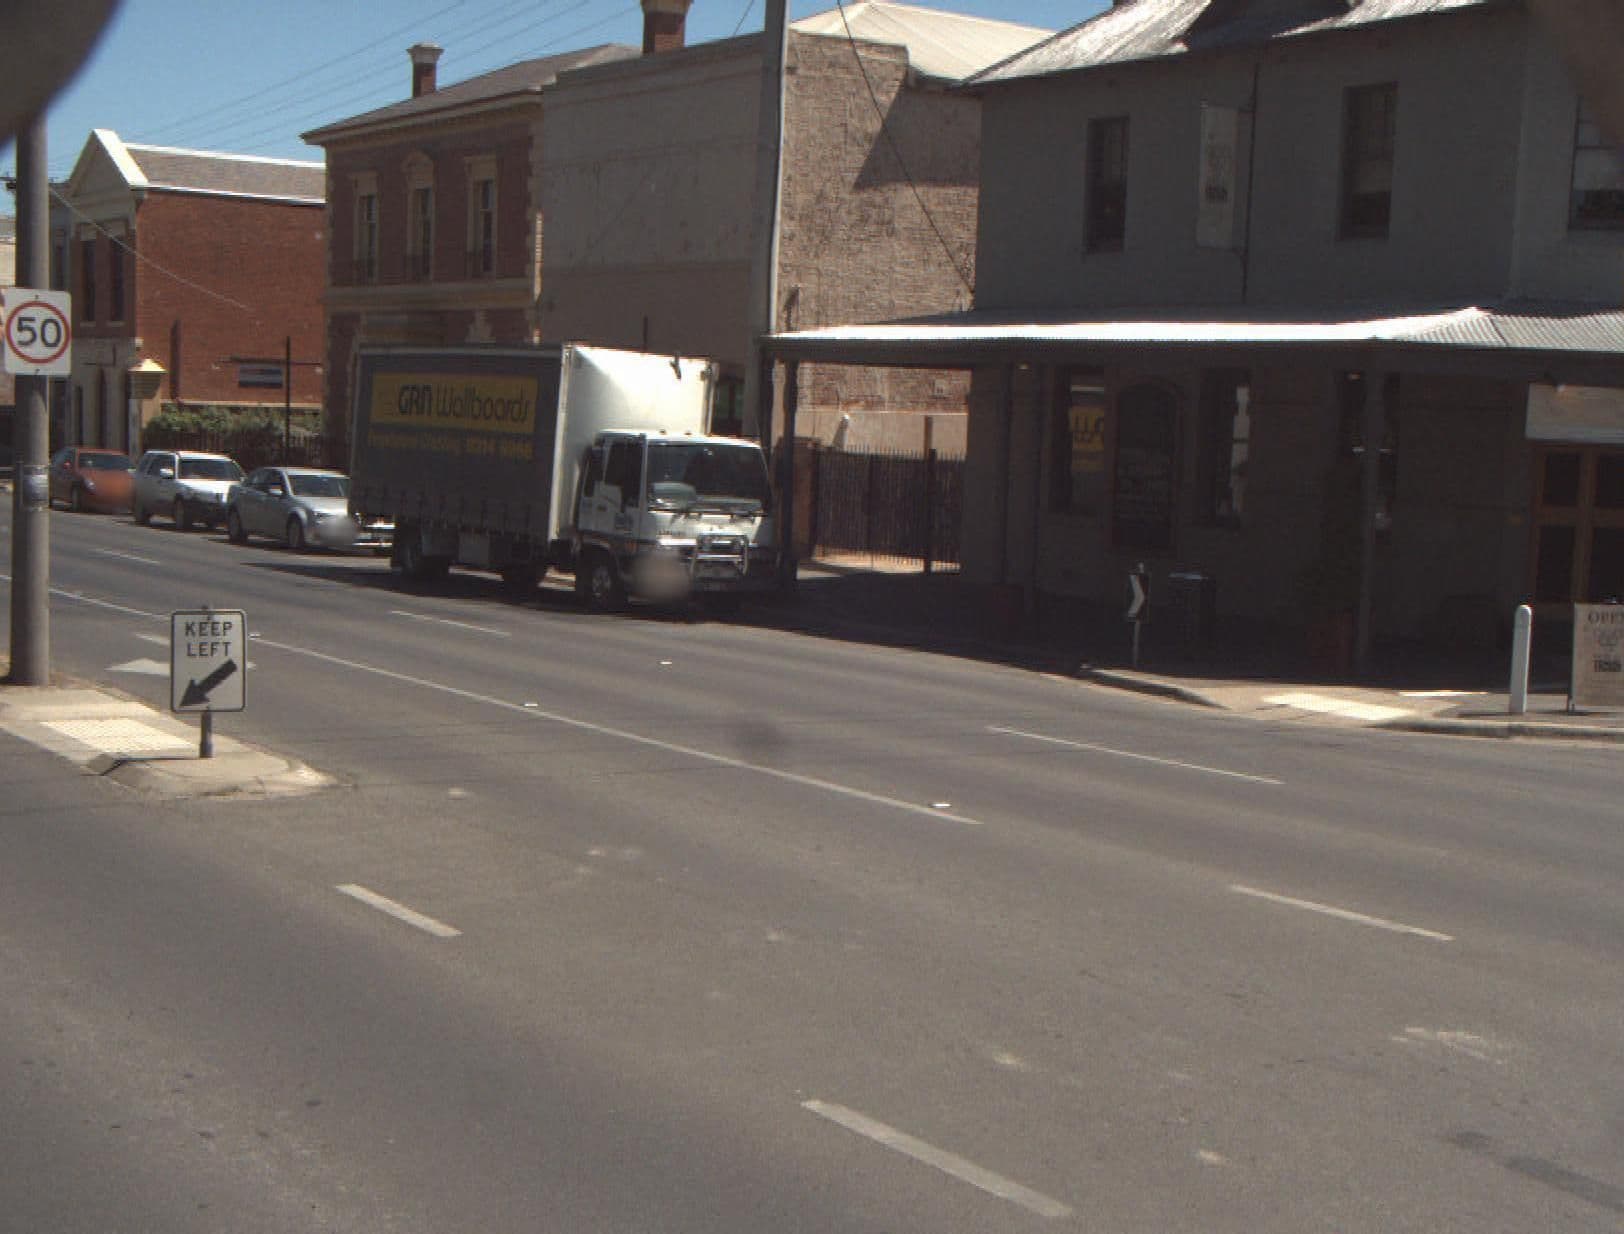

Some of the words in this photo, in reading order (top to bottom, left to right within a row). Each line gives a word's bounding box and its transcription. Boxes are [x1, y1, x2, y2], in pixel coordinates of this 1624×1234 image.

[17, 317, 60, 348] 50
[436, 384, 530, 423] Wallboards
[184, 621, 233, 637] KEEP
[188, 641, 231, 657] LEFT
